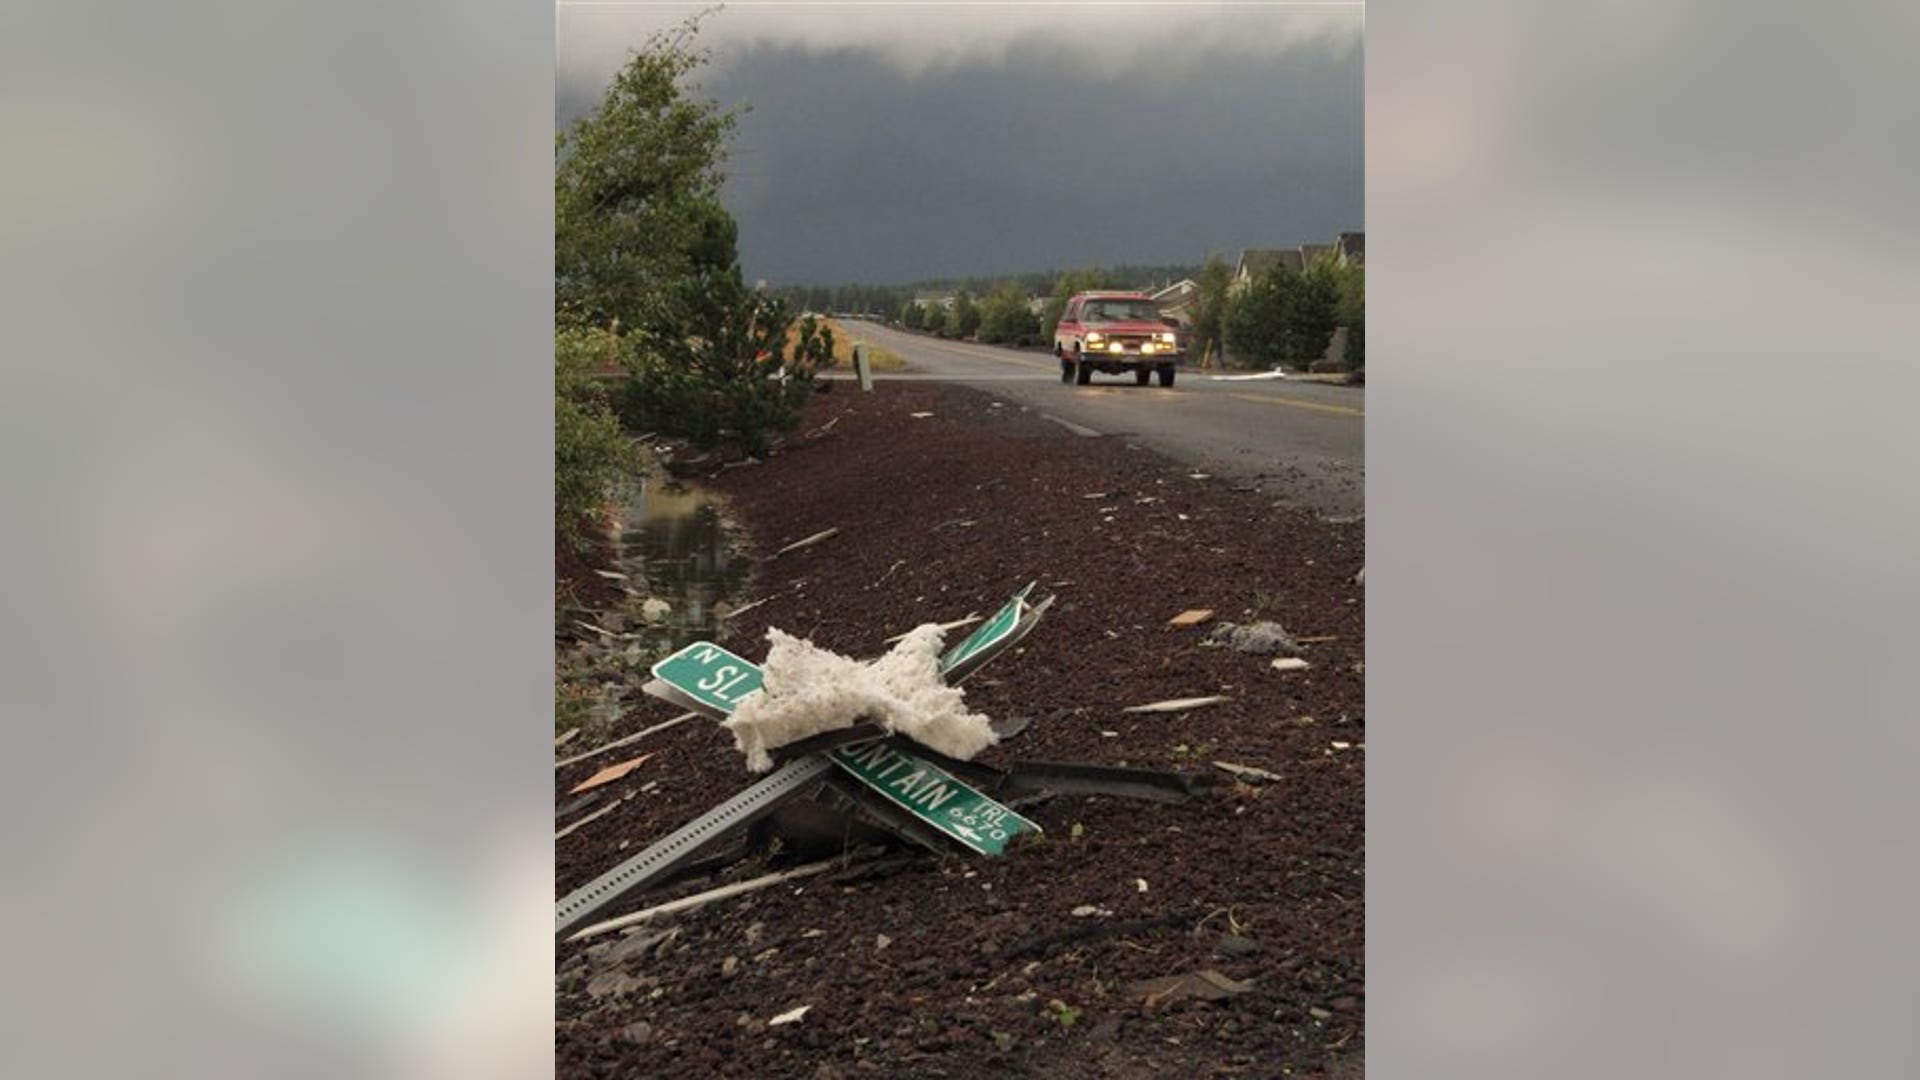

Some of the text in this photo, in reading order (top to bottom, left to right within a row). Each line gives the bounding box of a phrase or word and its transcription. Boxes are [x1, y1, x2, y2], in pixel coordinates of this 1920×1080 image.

[694, 648, 722, 664] N
[949, 807, 1007, 841] 6670
[972, 801, 1009, 828] TRL
